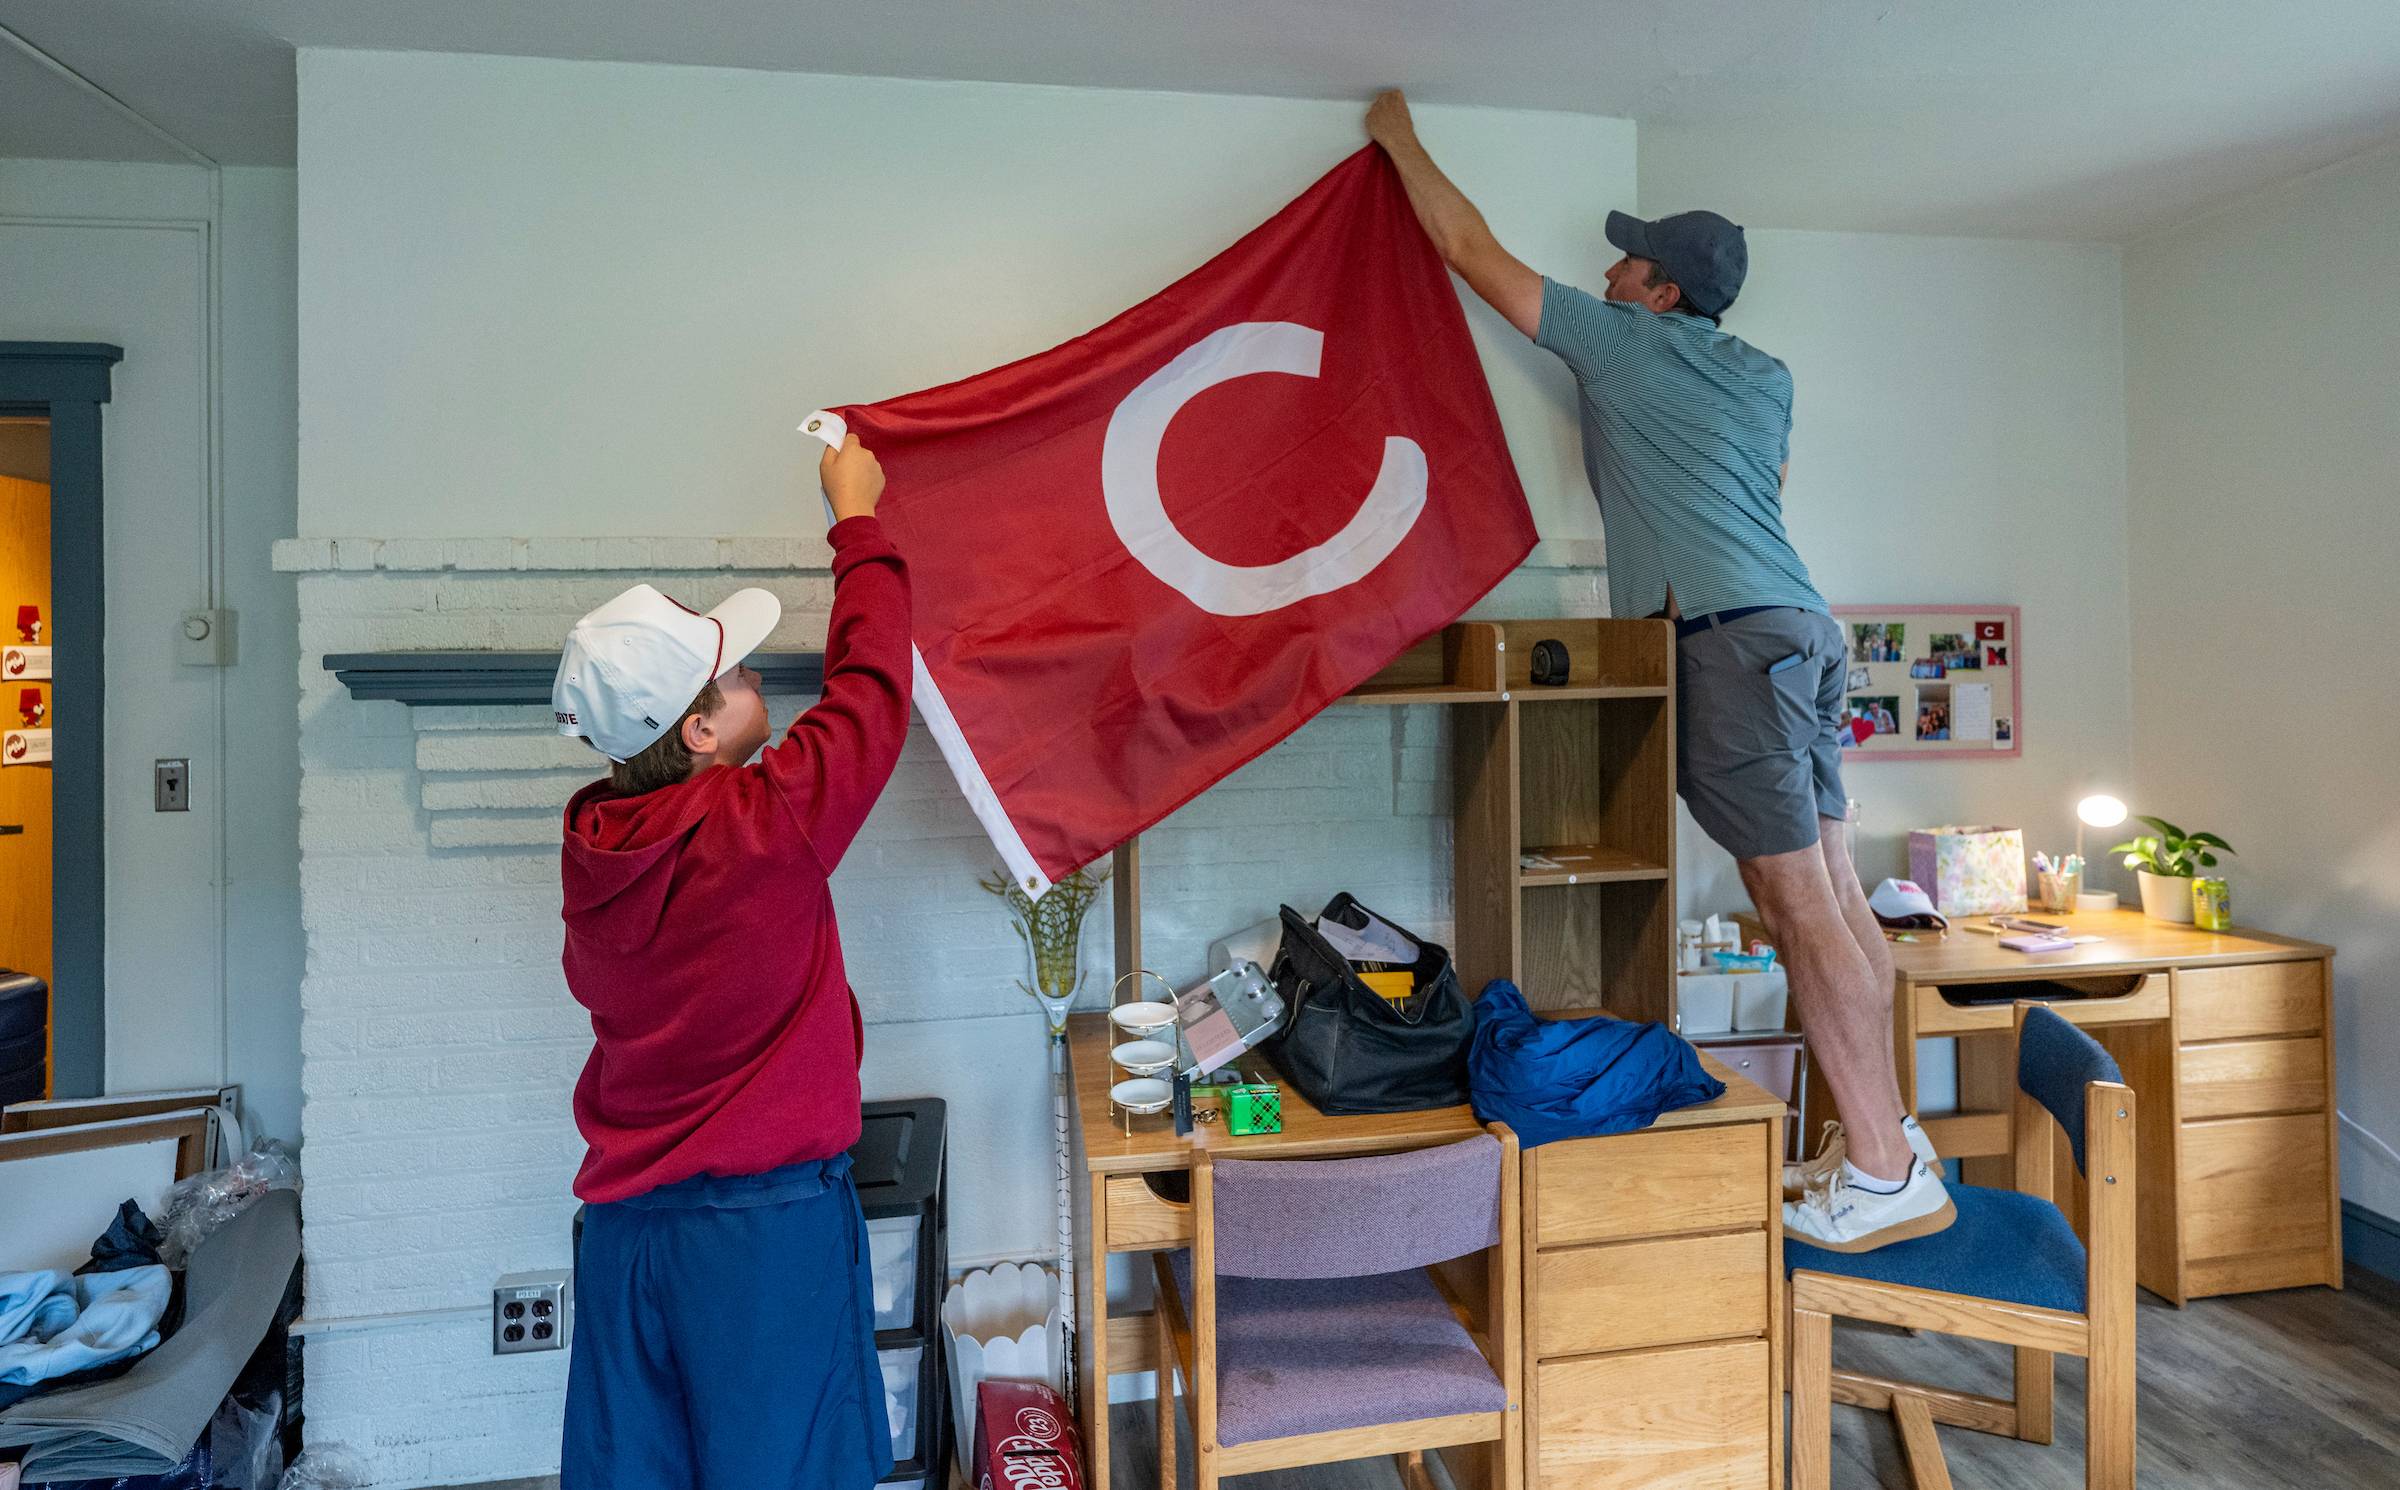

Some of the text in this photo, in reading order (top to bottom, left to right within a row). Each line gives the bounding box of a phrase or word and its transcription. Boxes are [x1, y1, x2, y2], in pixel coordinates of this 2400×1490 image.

[1102, 322, 1428, 616] C
[1984, 626, 1994, 637] C
[1028, 1418, 1049, 1433] 23
[1011, 1441, 1069, 1490] Peppr
